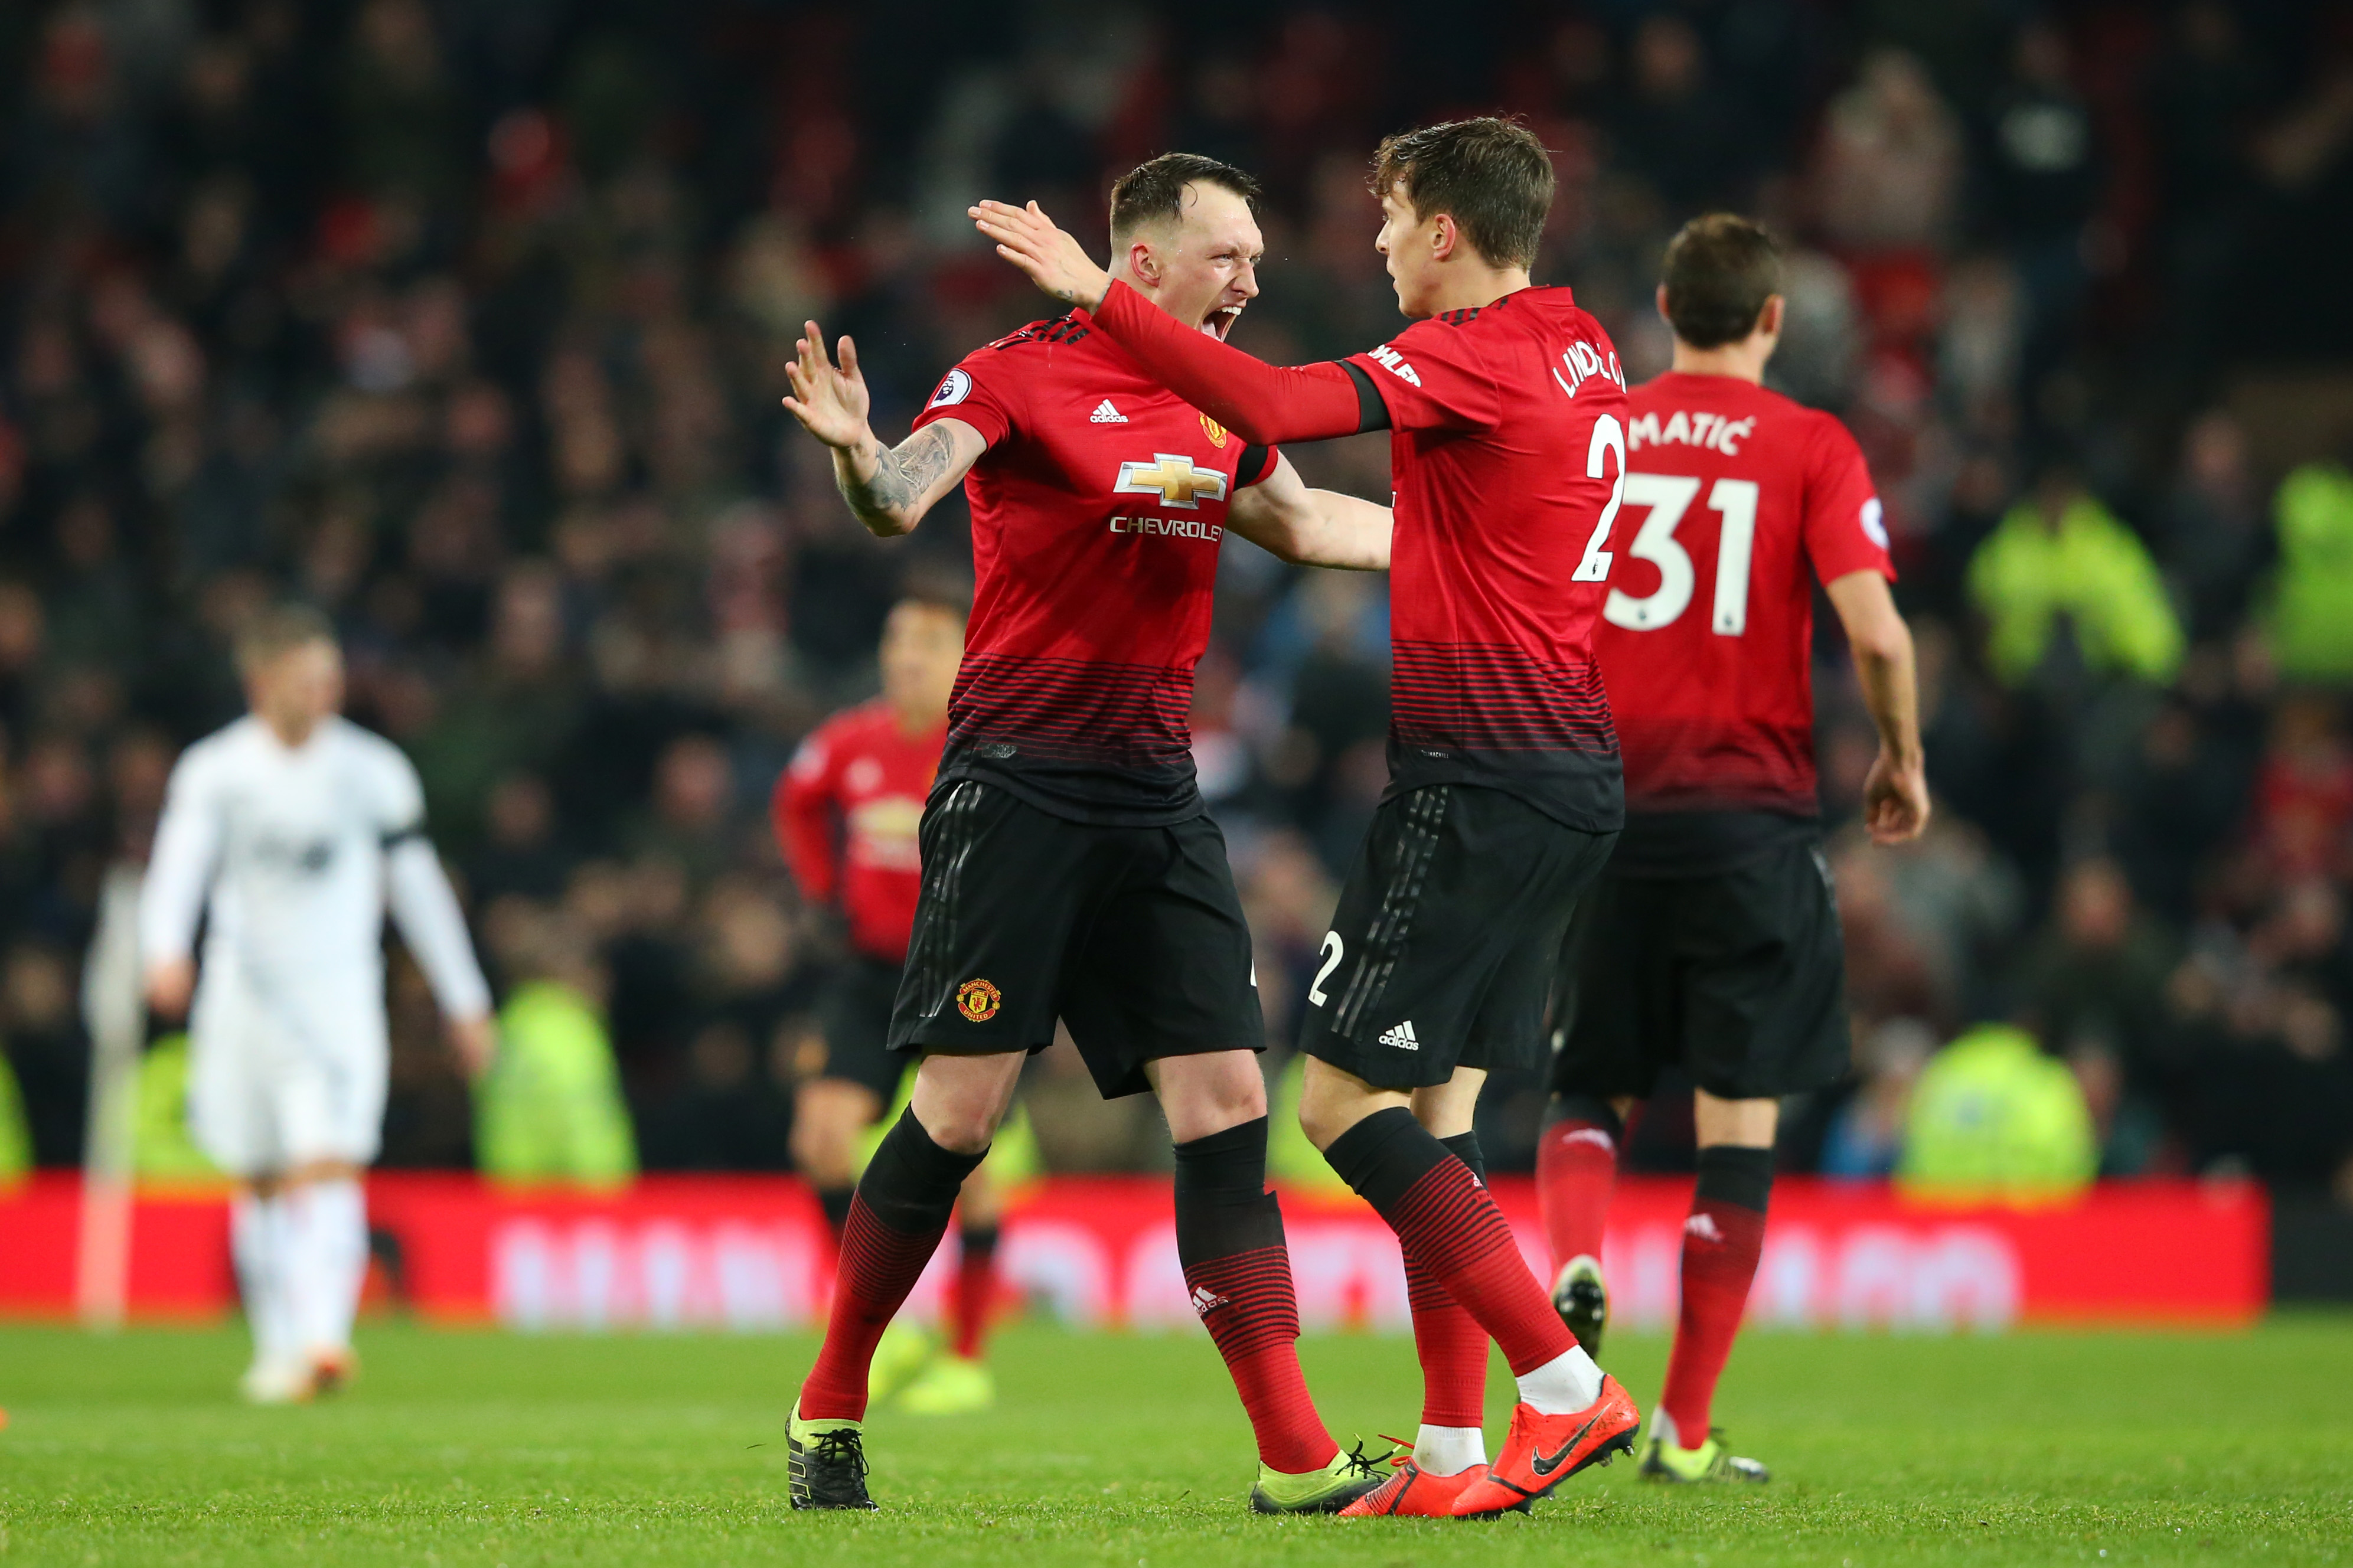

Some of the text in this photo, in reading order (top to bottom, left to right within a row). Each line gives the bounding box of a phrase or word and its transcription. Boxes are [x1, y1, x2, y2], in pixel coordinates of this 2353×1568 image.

[1089, 414, 1129, 423] adidas
[1571, 413, 1626, 582] 2
[1603, 472, 1759, 636] 31
[1308, 930, 1344, 1007] 2
[962, 981, 998, 999] MANCHESTER
[964, 1009, 988, 1020] UNITED
[1378, 1034, 1419, 1051] adidas
